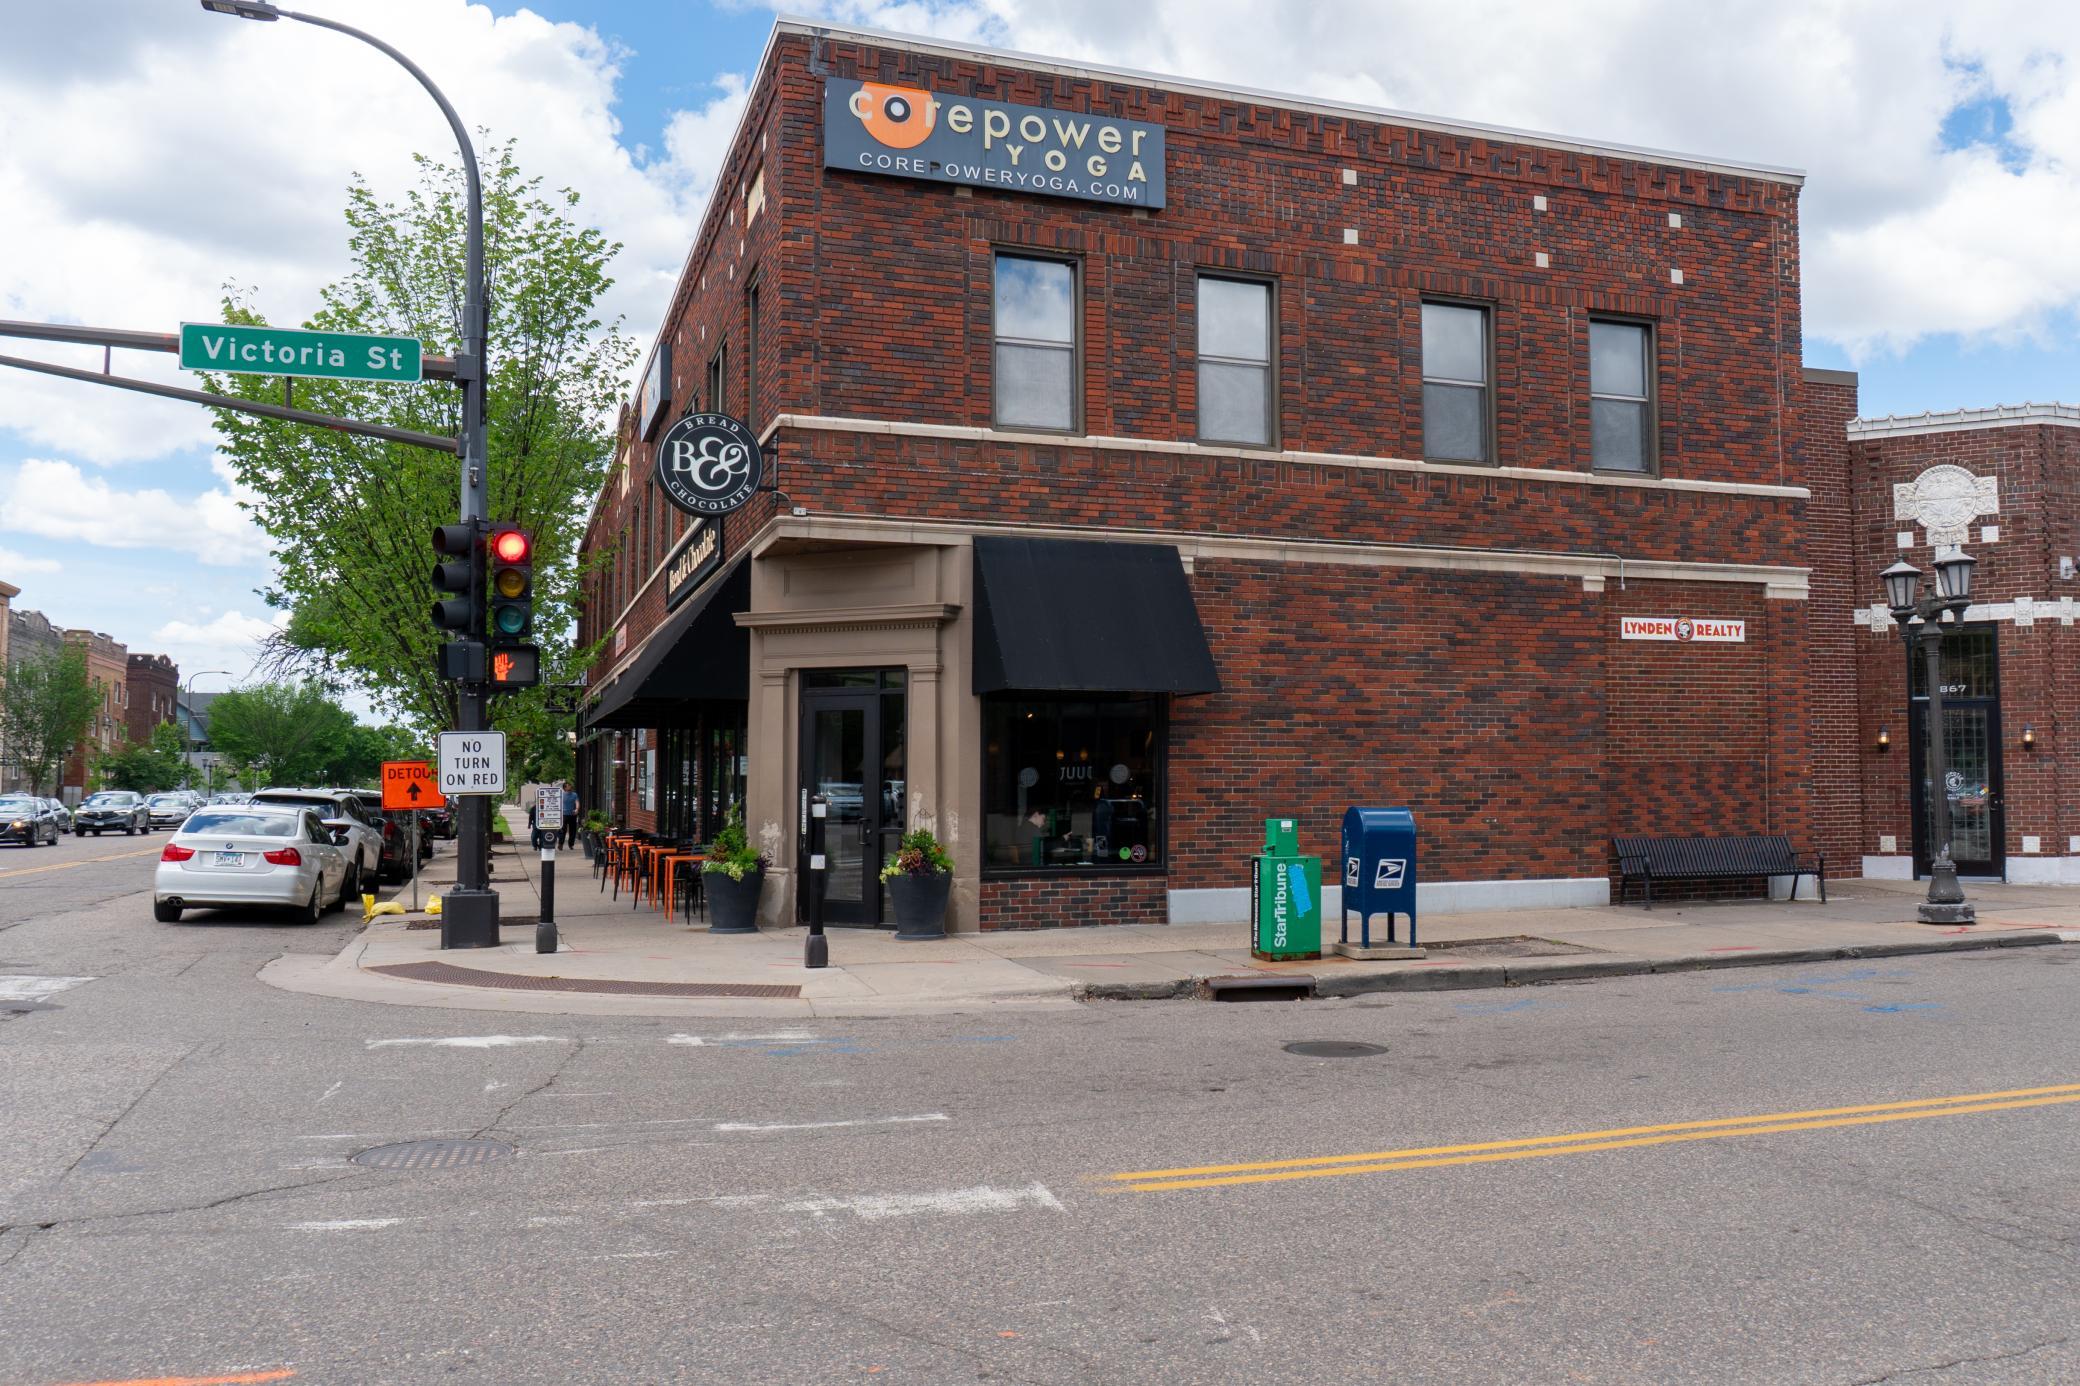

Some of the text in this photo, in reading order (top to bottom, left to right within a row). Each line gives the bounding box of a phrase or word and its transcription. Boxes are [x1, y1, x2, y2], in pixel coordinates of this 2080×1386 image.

[849, 90, 1147, 156] corepower
[1005, 143, 1147, 182] YOGA
[202, 335, 402, 371] Victoria St
[684, 416, 739, 432] BREAD
[671, 481, 752, 510] CHOCOLATE
[1624, 621, 1742, 637] LYNDEN REALTY
[1939, 684, 1967, 693] 867
[462, 740, 482, 753] NO
[454, 757, 490, 769] TURN
[446, 773, 498, 786] ON RED
[1274, 862, 1287, 948] StarTribune
